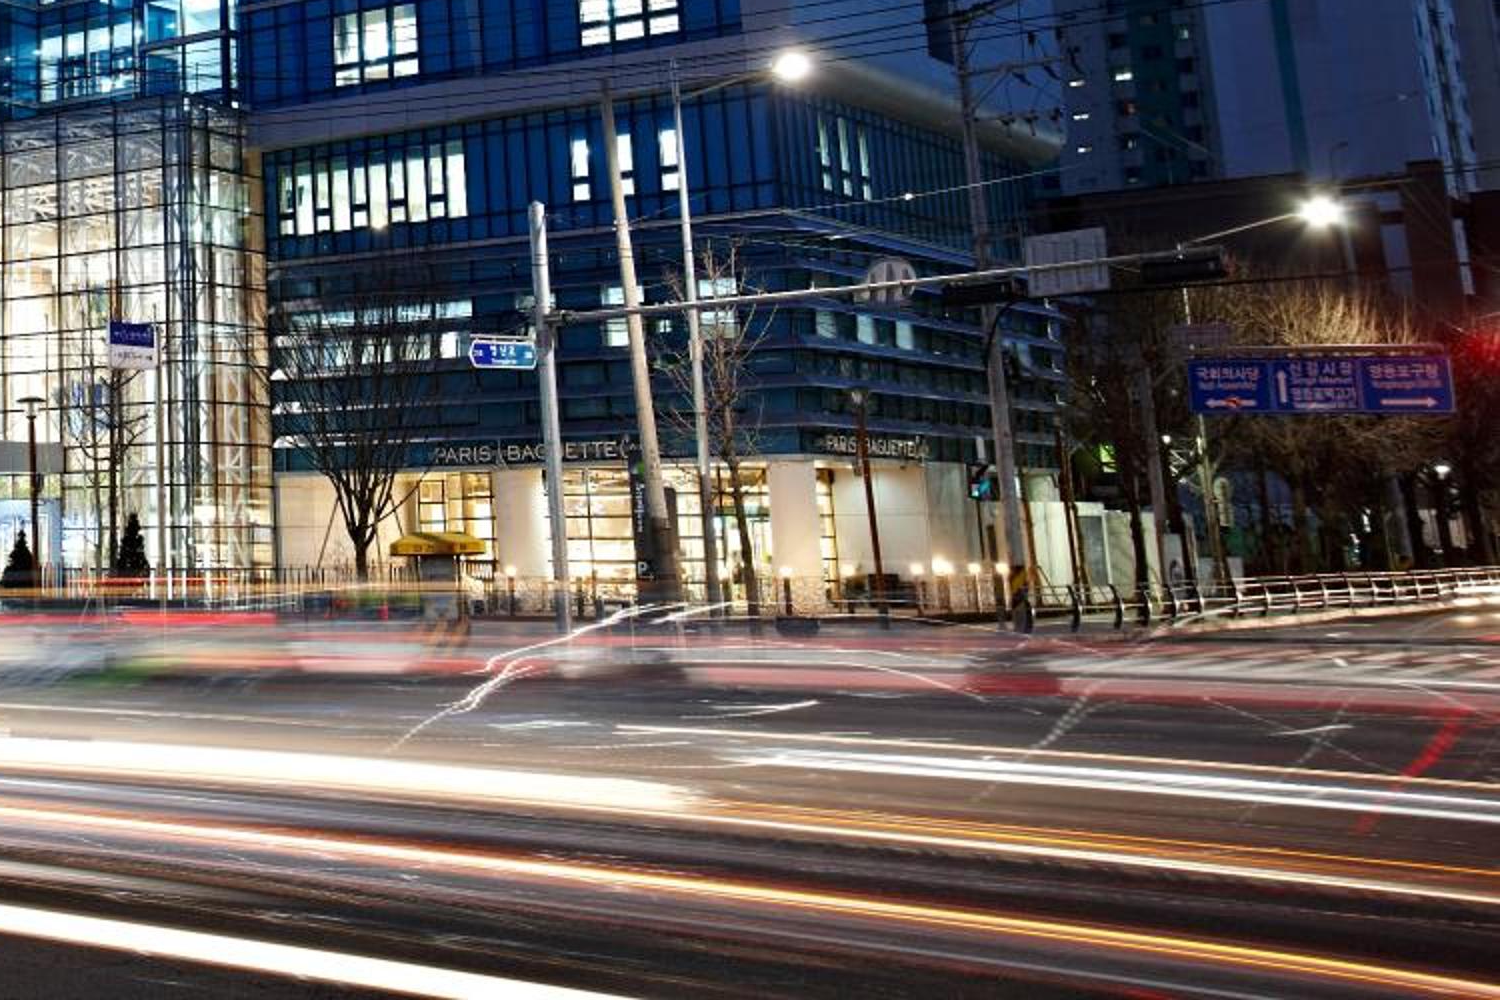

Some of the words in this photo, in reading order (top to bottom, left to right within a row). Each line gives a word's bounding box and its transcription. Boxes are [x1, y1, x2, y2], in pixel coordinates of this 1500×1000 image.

[1196, 367, 1259, 381] 국회의사당
[434, 445, 492, 464] PARIS
[507, 441, 618, 461] BAGETTE
